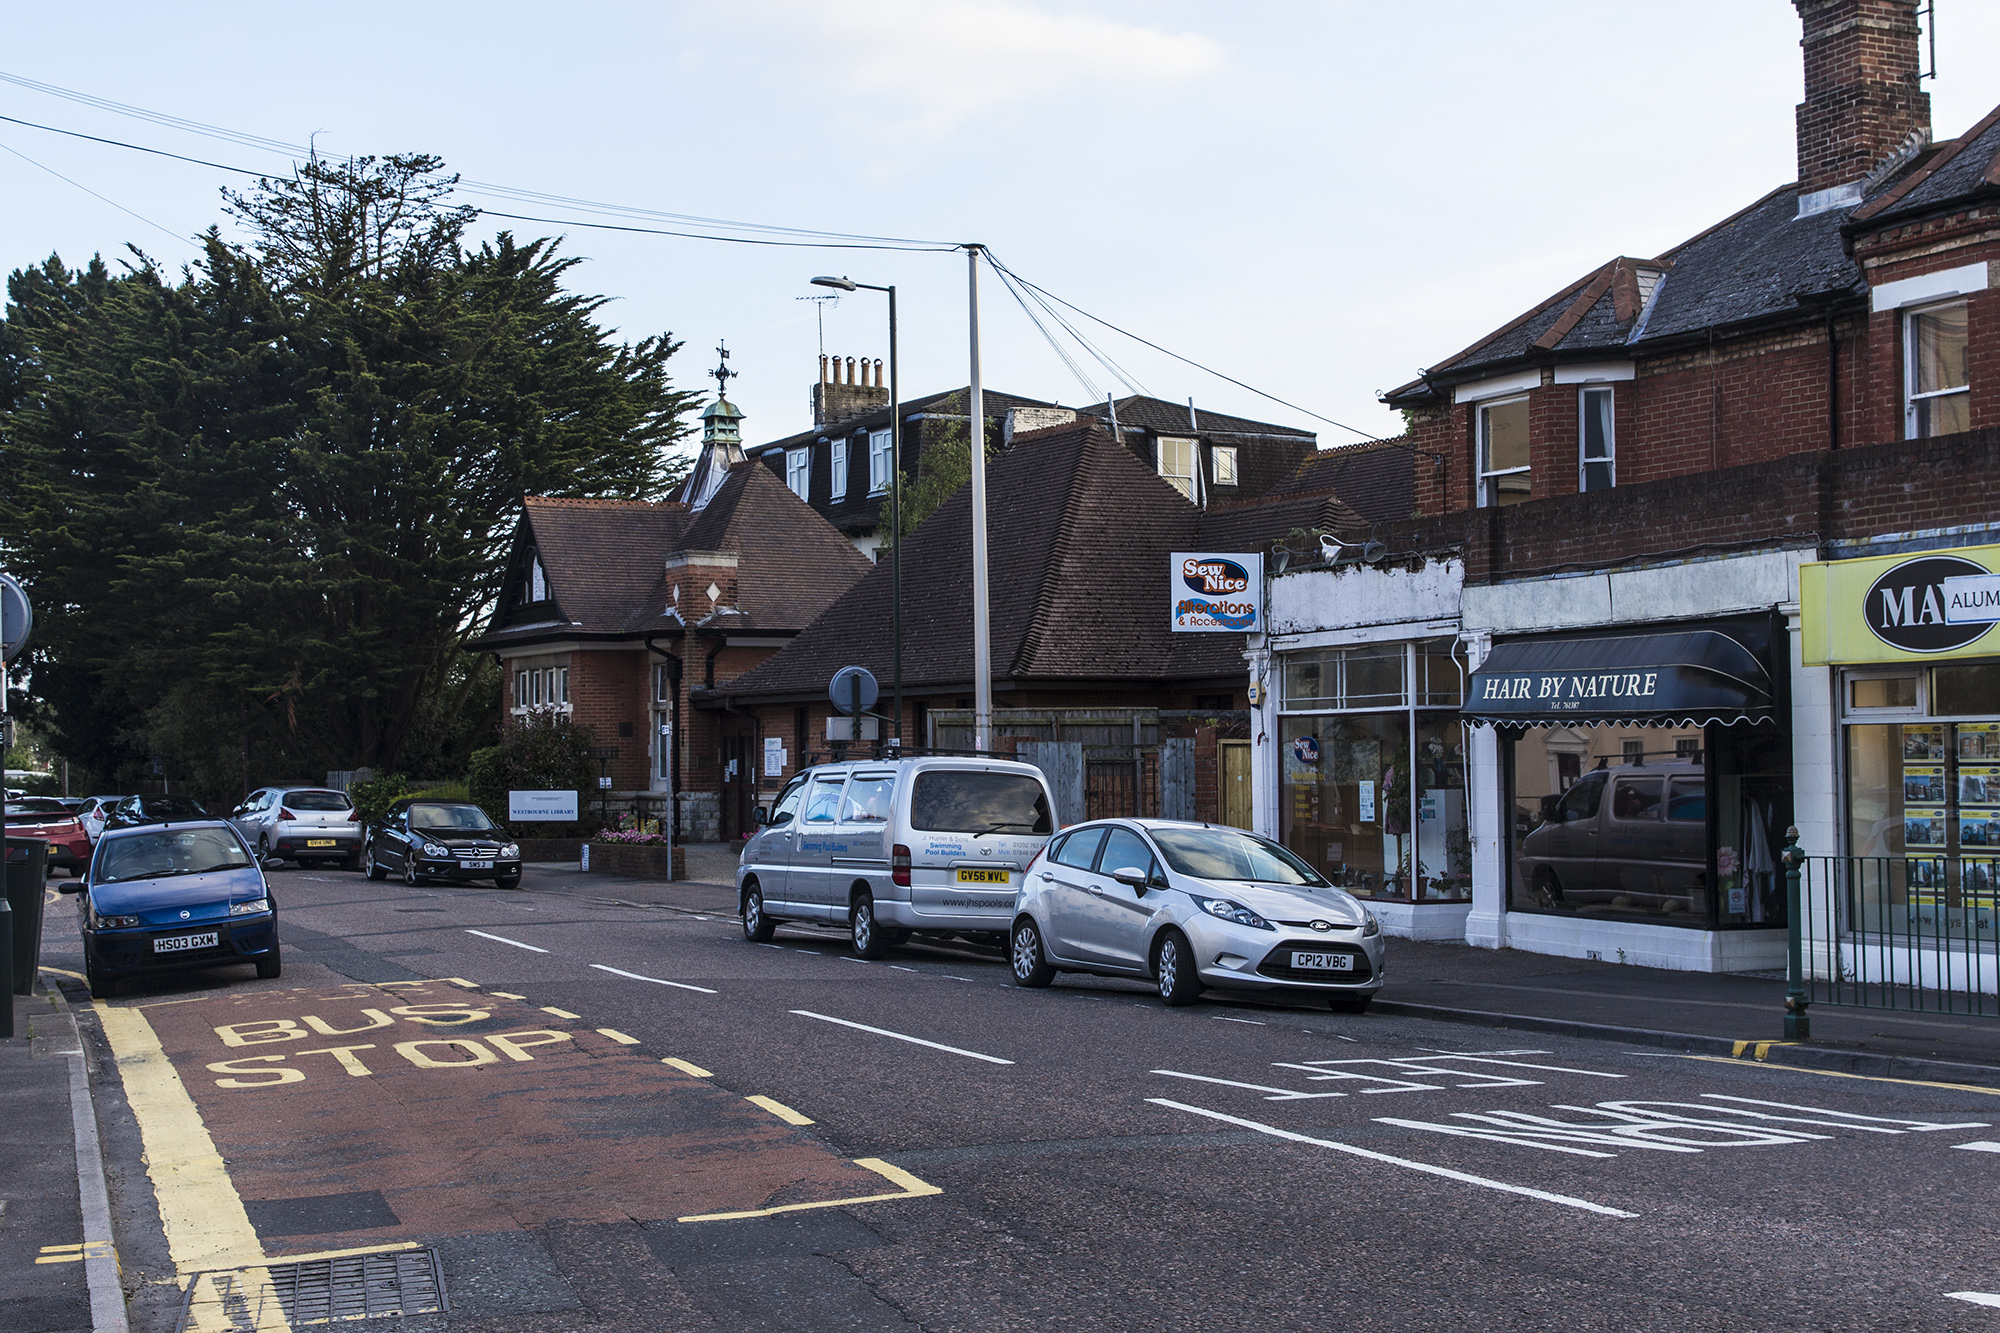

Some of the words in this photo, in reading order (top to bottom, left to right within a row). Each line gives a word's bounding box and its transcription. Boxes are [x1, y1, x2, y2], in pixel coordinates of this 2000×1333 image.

[1183, 560, 1224, 576] Sew
[1204, 575, 1246, 590] Nice
[1178, 600, 1254, 614] Alterations
[1178, 616, 1185, 626] &
[1190, 616, 1254, 626] Accessories
[1482, 677, 1531, 699] HAIR
[1537, 676, 1566, 698] BY
[1569, 673, 1657, 698] NATURE
[1550, 701, 1561, 709] Tel.
[1295, 738, 1310, 749] Sew
[1302, 748, 1319, 759] Nice
[930, 842, 962, 851] Swimming
[941, 849, 966, 857] Builders
[961, 871, 985, 881] GV56
[988, 871, 1005, 882] WVL
[158, 938, 188, 950] HS03
[191, 934, 214, 947] GXM
[1298, 953, 1323, 967] CP12
[1326, 955, 1347, 968] VBG
[212, 1003, 491, 1048] BUS
[206, 1030, 573, 1088] STOP
